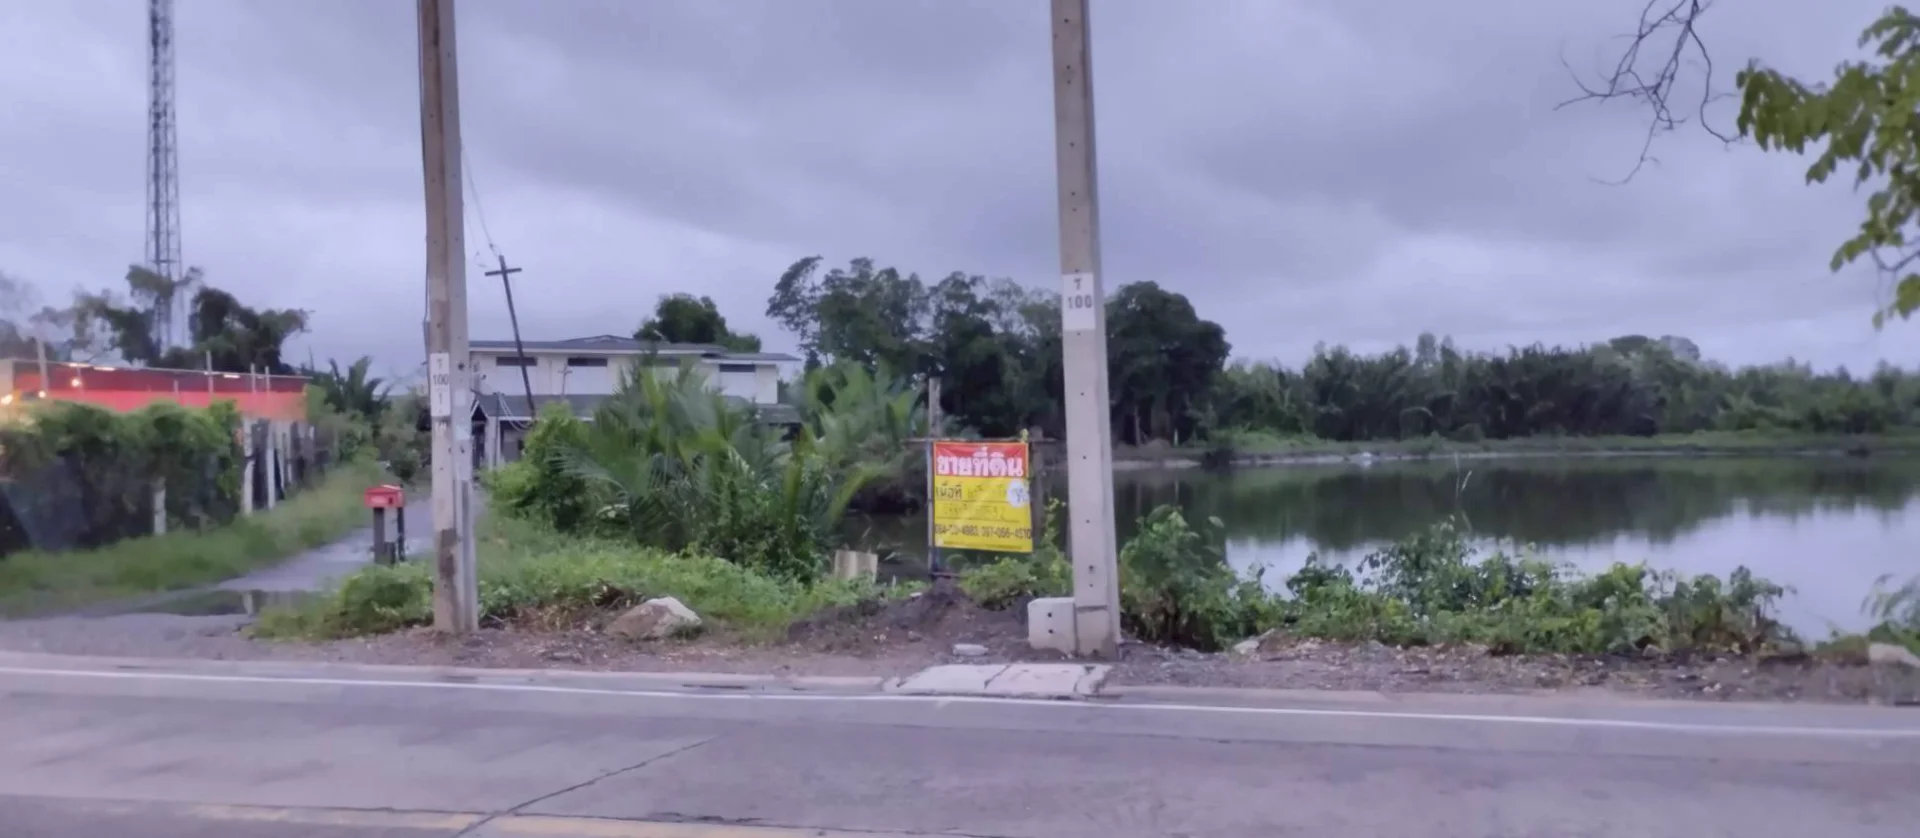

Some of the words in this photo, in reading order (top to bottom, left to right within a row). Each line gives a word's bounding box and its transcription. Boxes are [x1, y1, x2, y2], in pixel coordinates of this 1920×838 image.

[1067, 295, 1093, 309] 100
[433, 374, 449, 386] 100
[937, 446, 1024, 476] ขายที่ดิน
